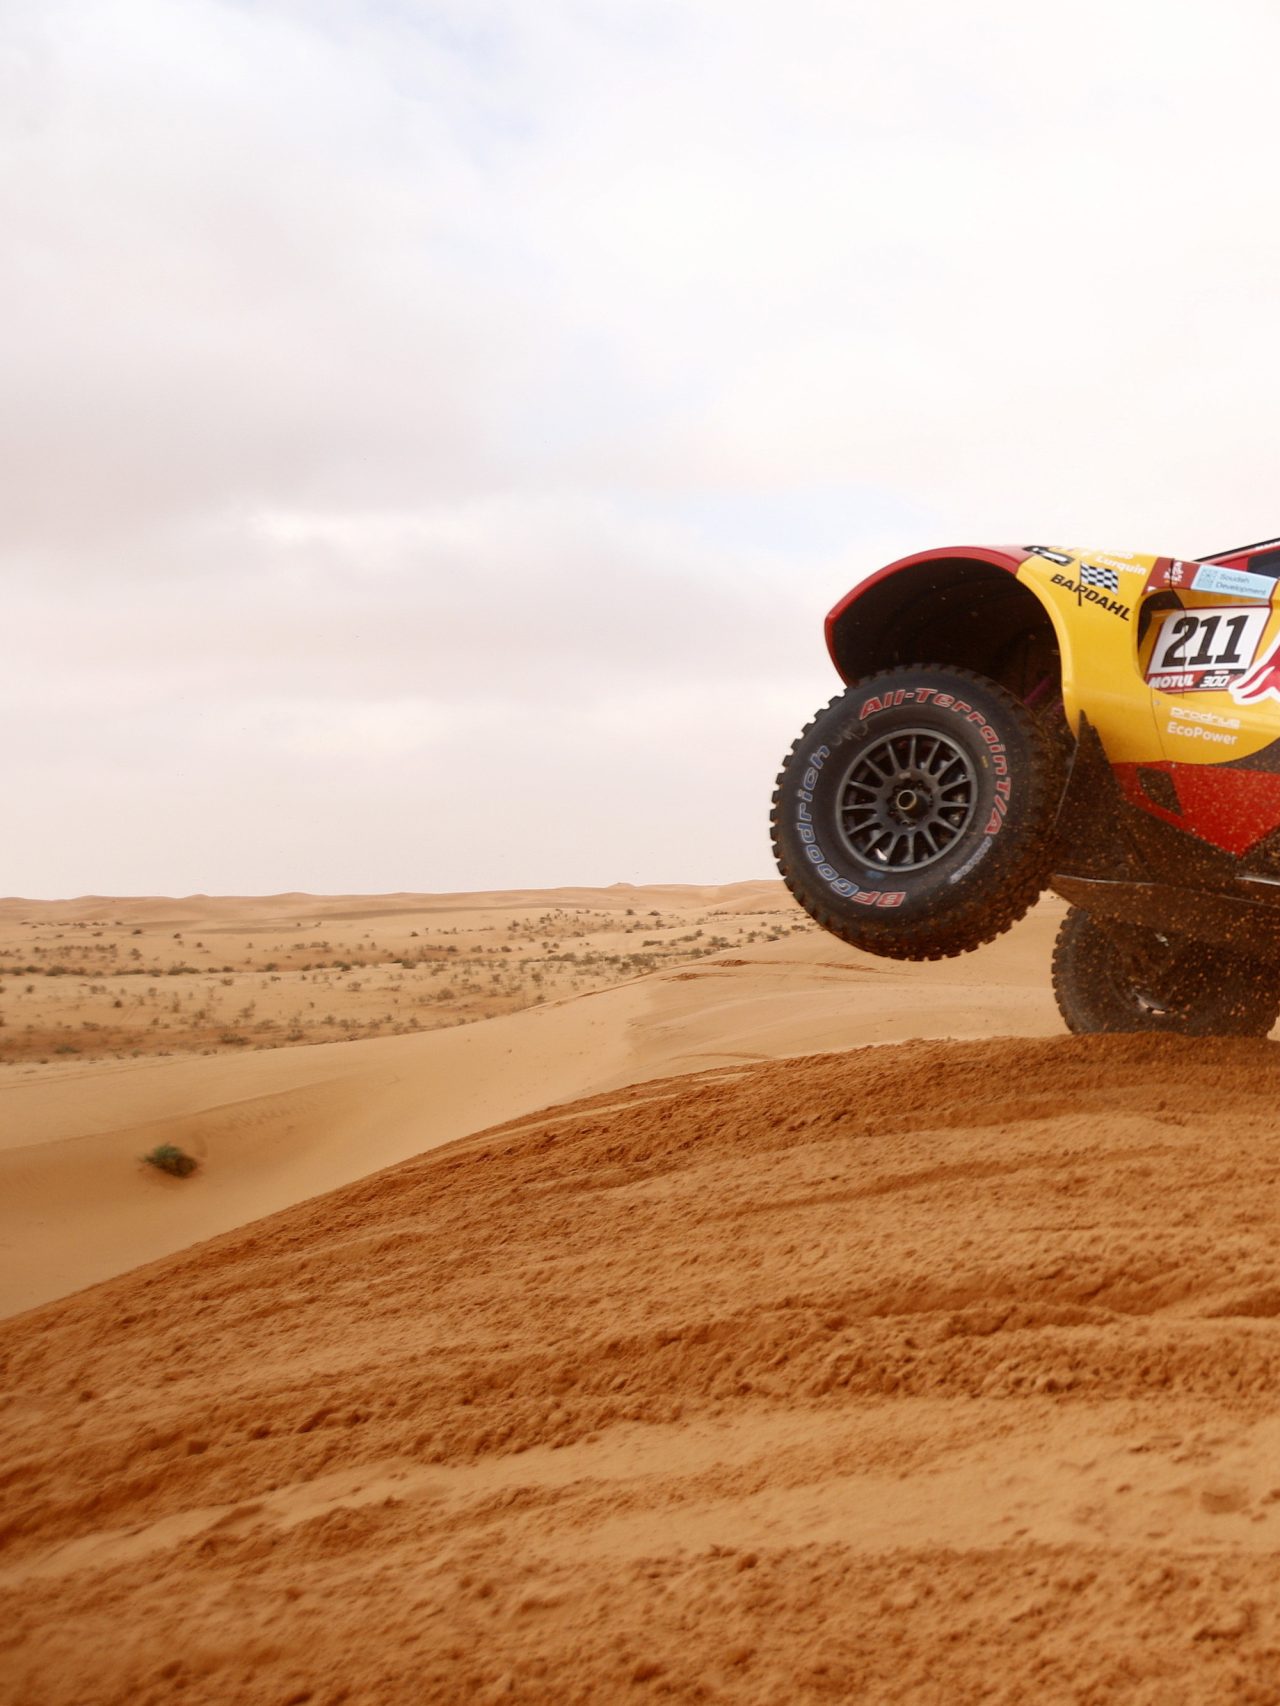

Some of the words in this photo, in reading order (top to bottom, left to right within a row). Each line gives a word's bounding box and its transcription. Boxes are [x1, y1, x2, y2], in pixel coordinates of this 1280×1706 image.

[1050, 574, 1131, 622] BARDAHL
[1161, 615, 1249, 667] 211
[1149, 674, 1194, 689] MOTUL
[1167, 721, 1239, 745] EcoPower
[797, 744, 906, 908] BFGoodrich
